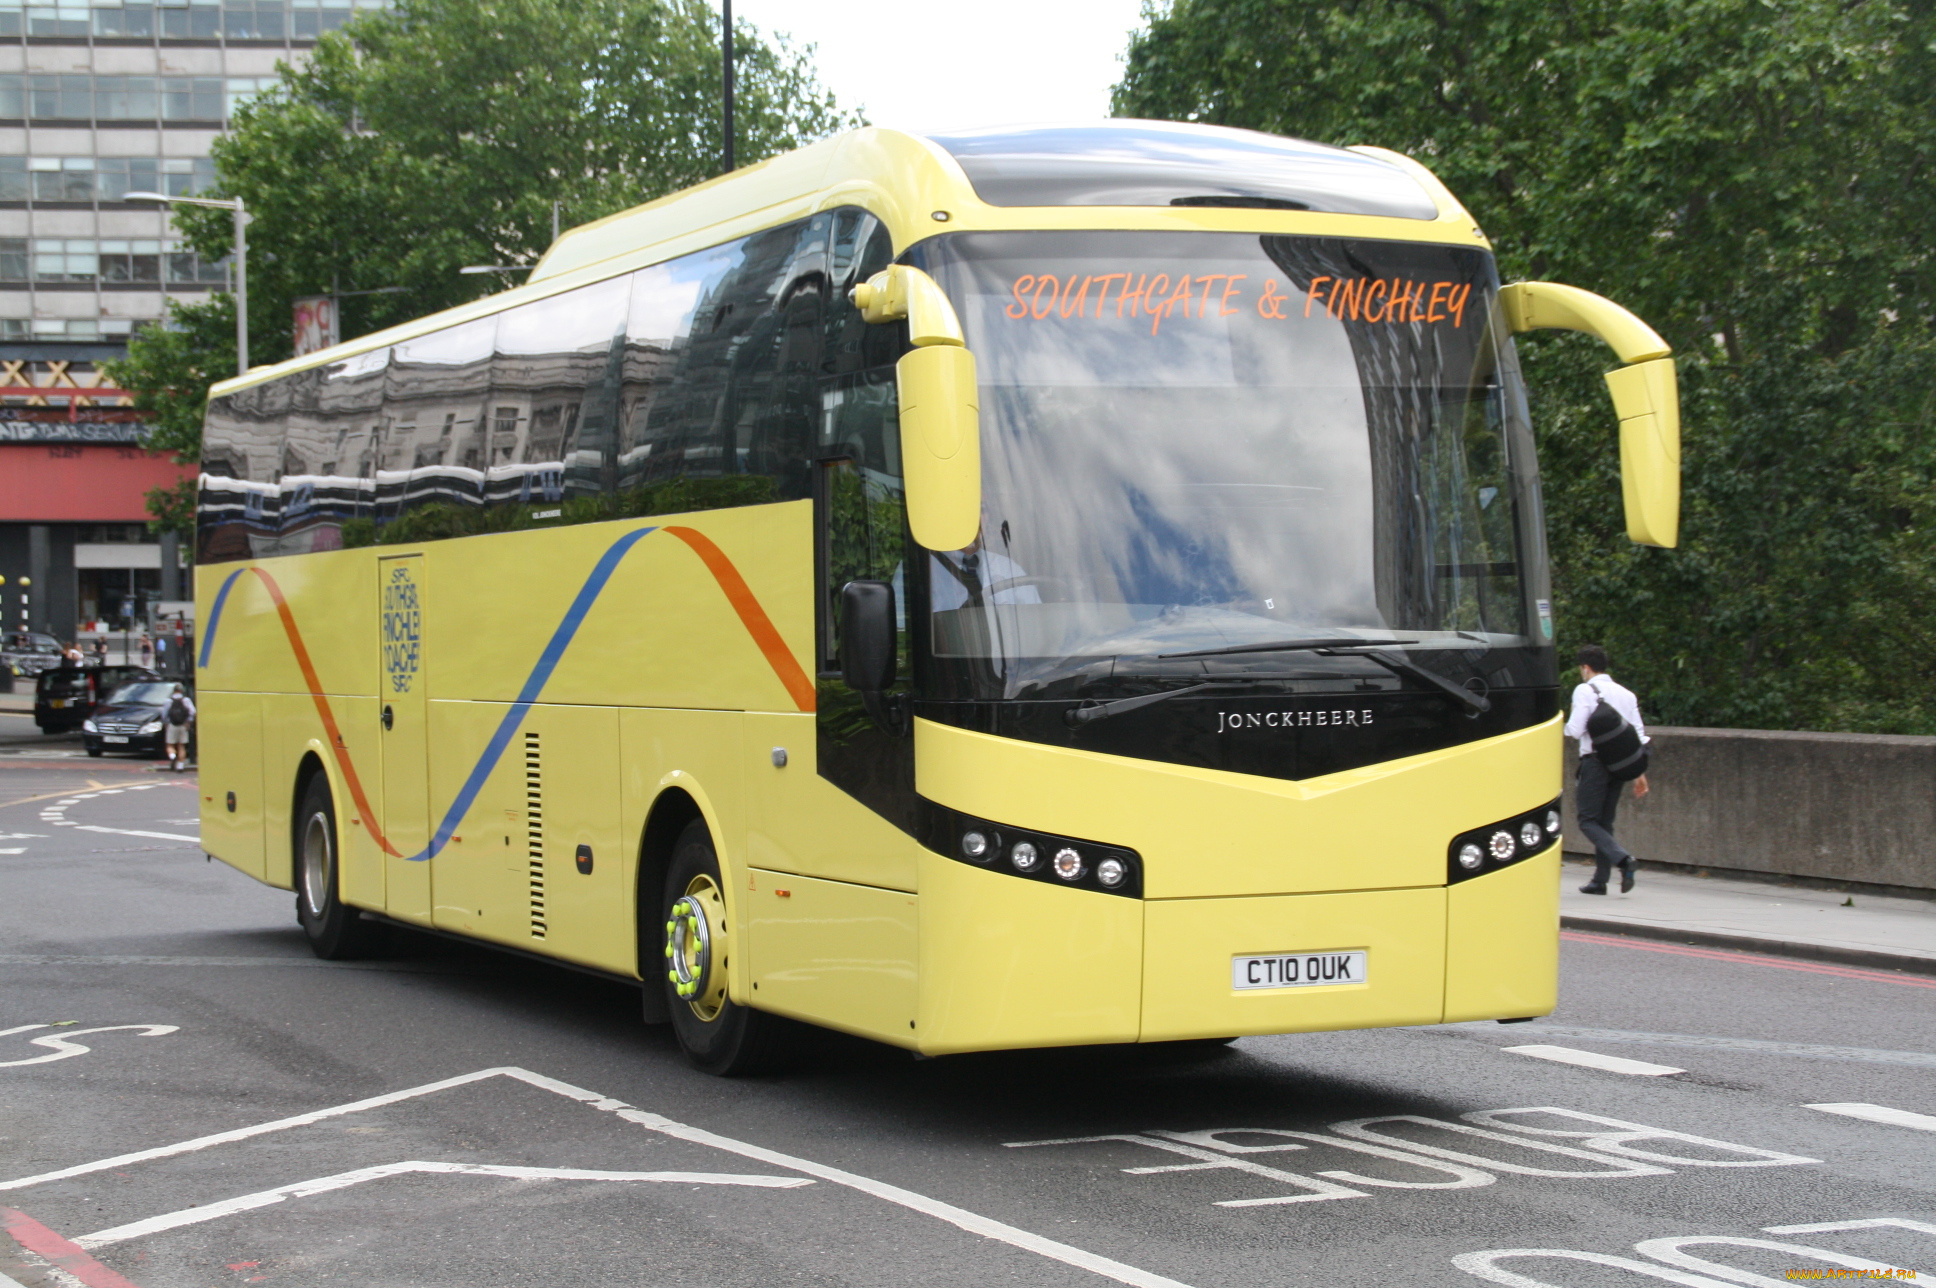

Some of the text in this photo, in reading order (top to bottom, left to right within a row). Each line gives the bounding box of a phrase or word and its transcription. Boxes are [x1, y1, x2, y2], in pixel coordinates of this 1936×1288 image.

[1005, 272, 1472, 336] SOUTHGATE & FINCHLEY
[1217, 709, 1374, 734] JONCKHEERE
[1247, 955, 1351, 984] CT10 OUK
